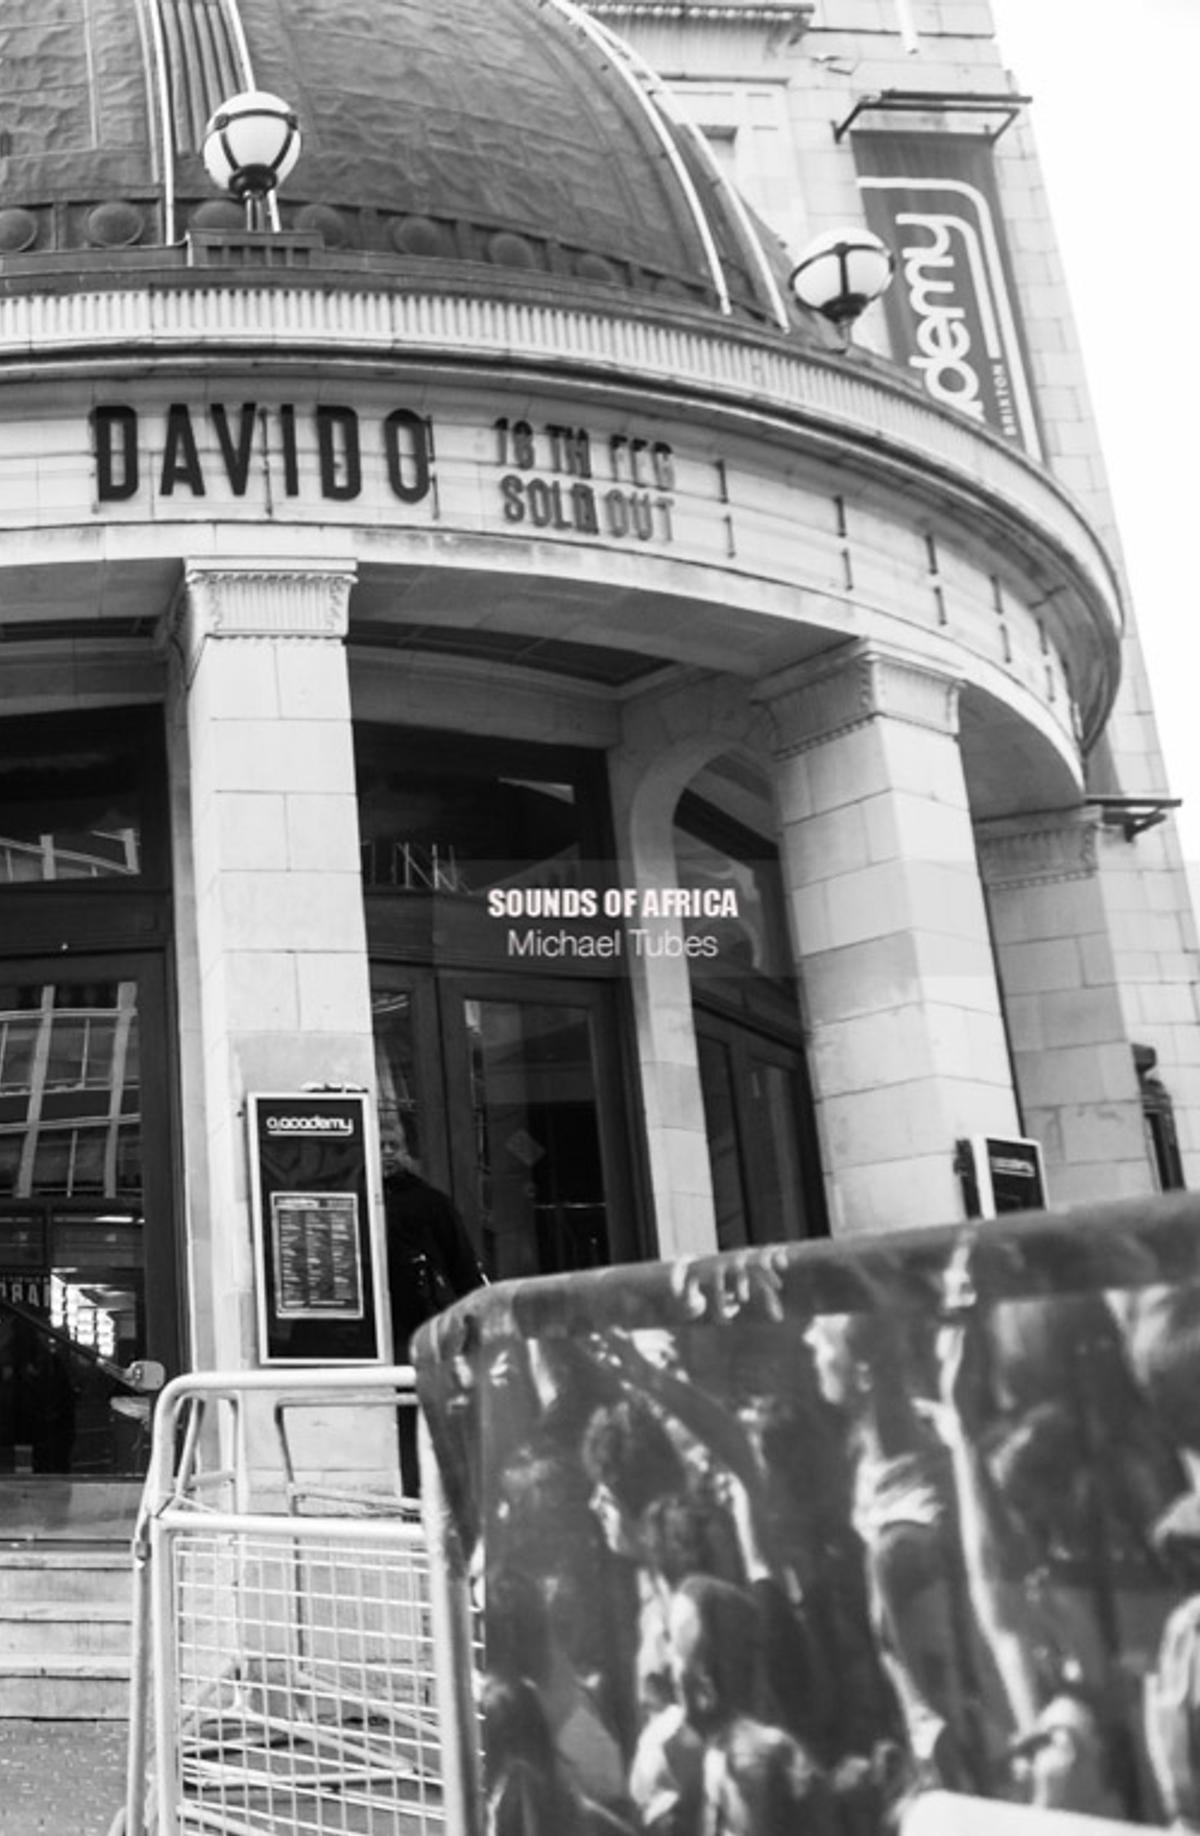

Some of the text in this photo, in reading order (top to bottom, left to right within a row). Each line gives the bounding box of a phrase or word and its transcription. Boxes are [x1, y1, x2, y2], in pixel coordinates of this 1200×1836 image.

[94, 402, 431, 505] DAVIDO
[501, 474, 676, 542] SOLD OUT
